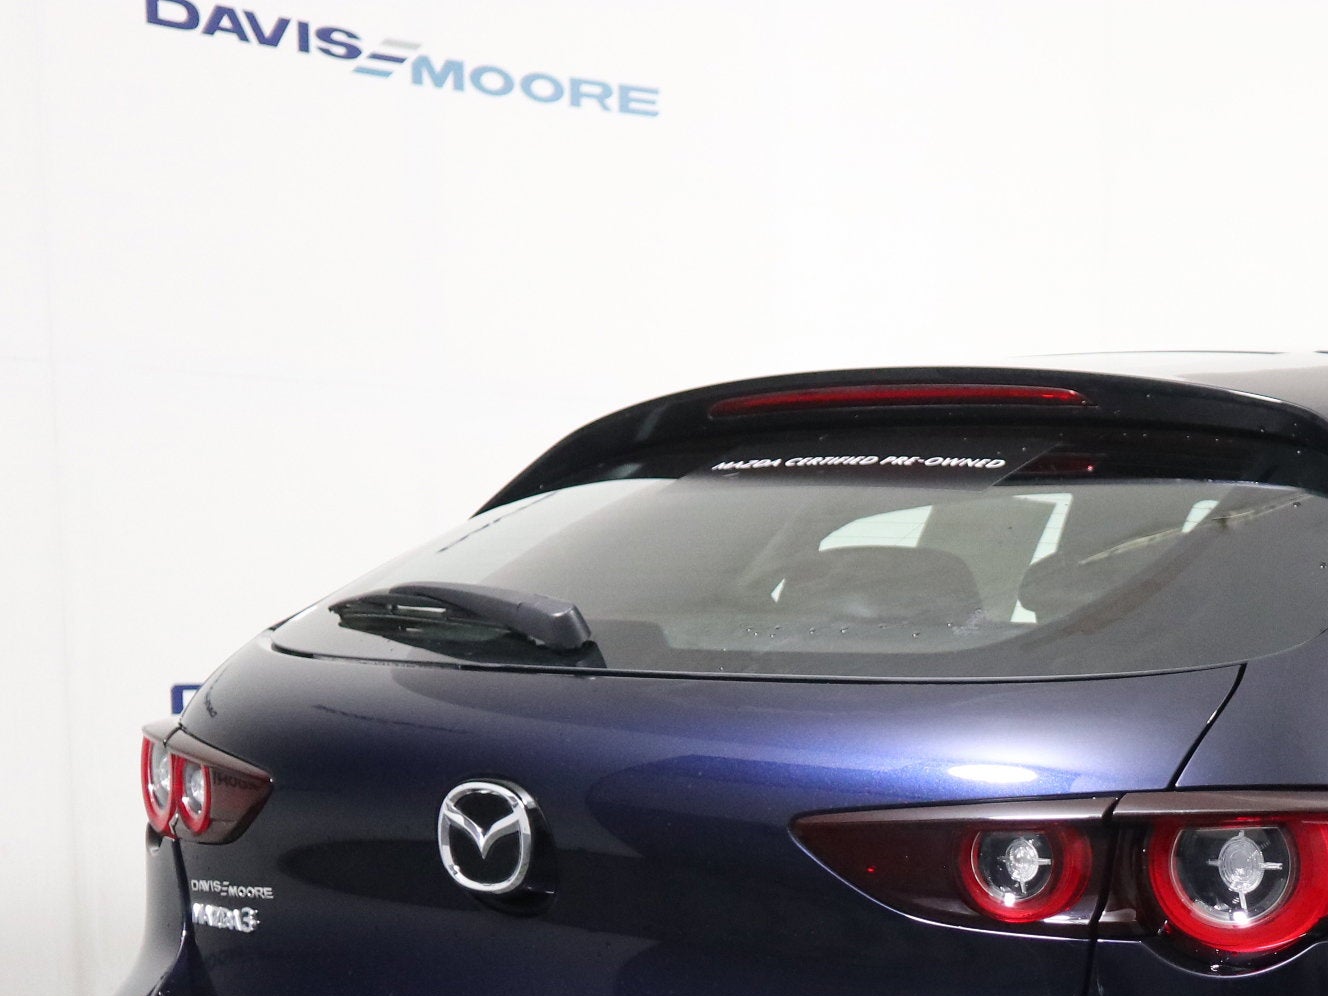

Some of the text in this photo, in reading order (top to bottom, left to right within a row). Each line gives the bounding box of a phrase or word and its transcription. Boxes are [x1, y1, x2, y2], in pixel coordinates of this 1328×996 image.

[145, 0, 660, 117] DAVIS MOORE
[711, 456, 1006, 471] MAZDA CERTIFIED PRE-OWNED
[191, 880, 274, 899] DAVIS MOORE
